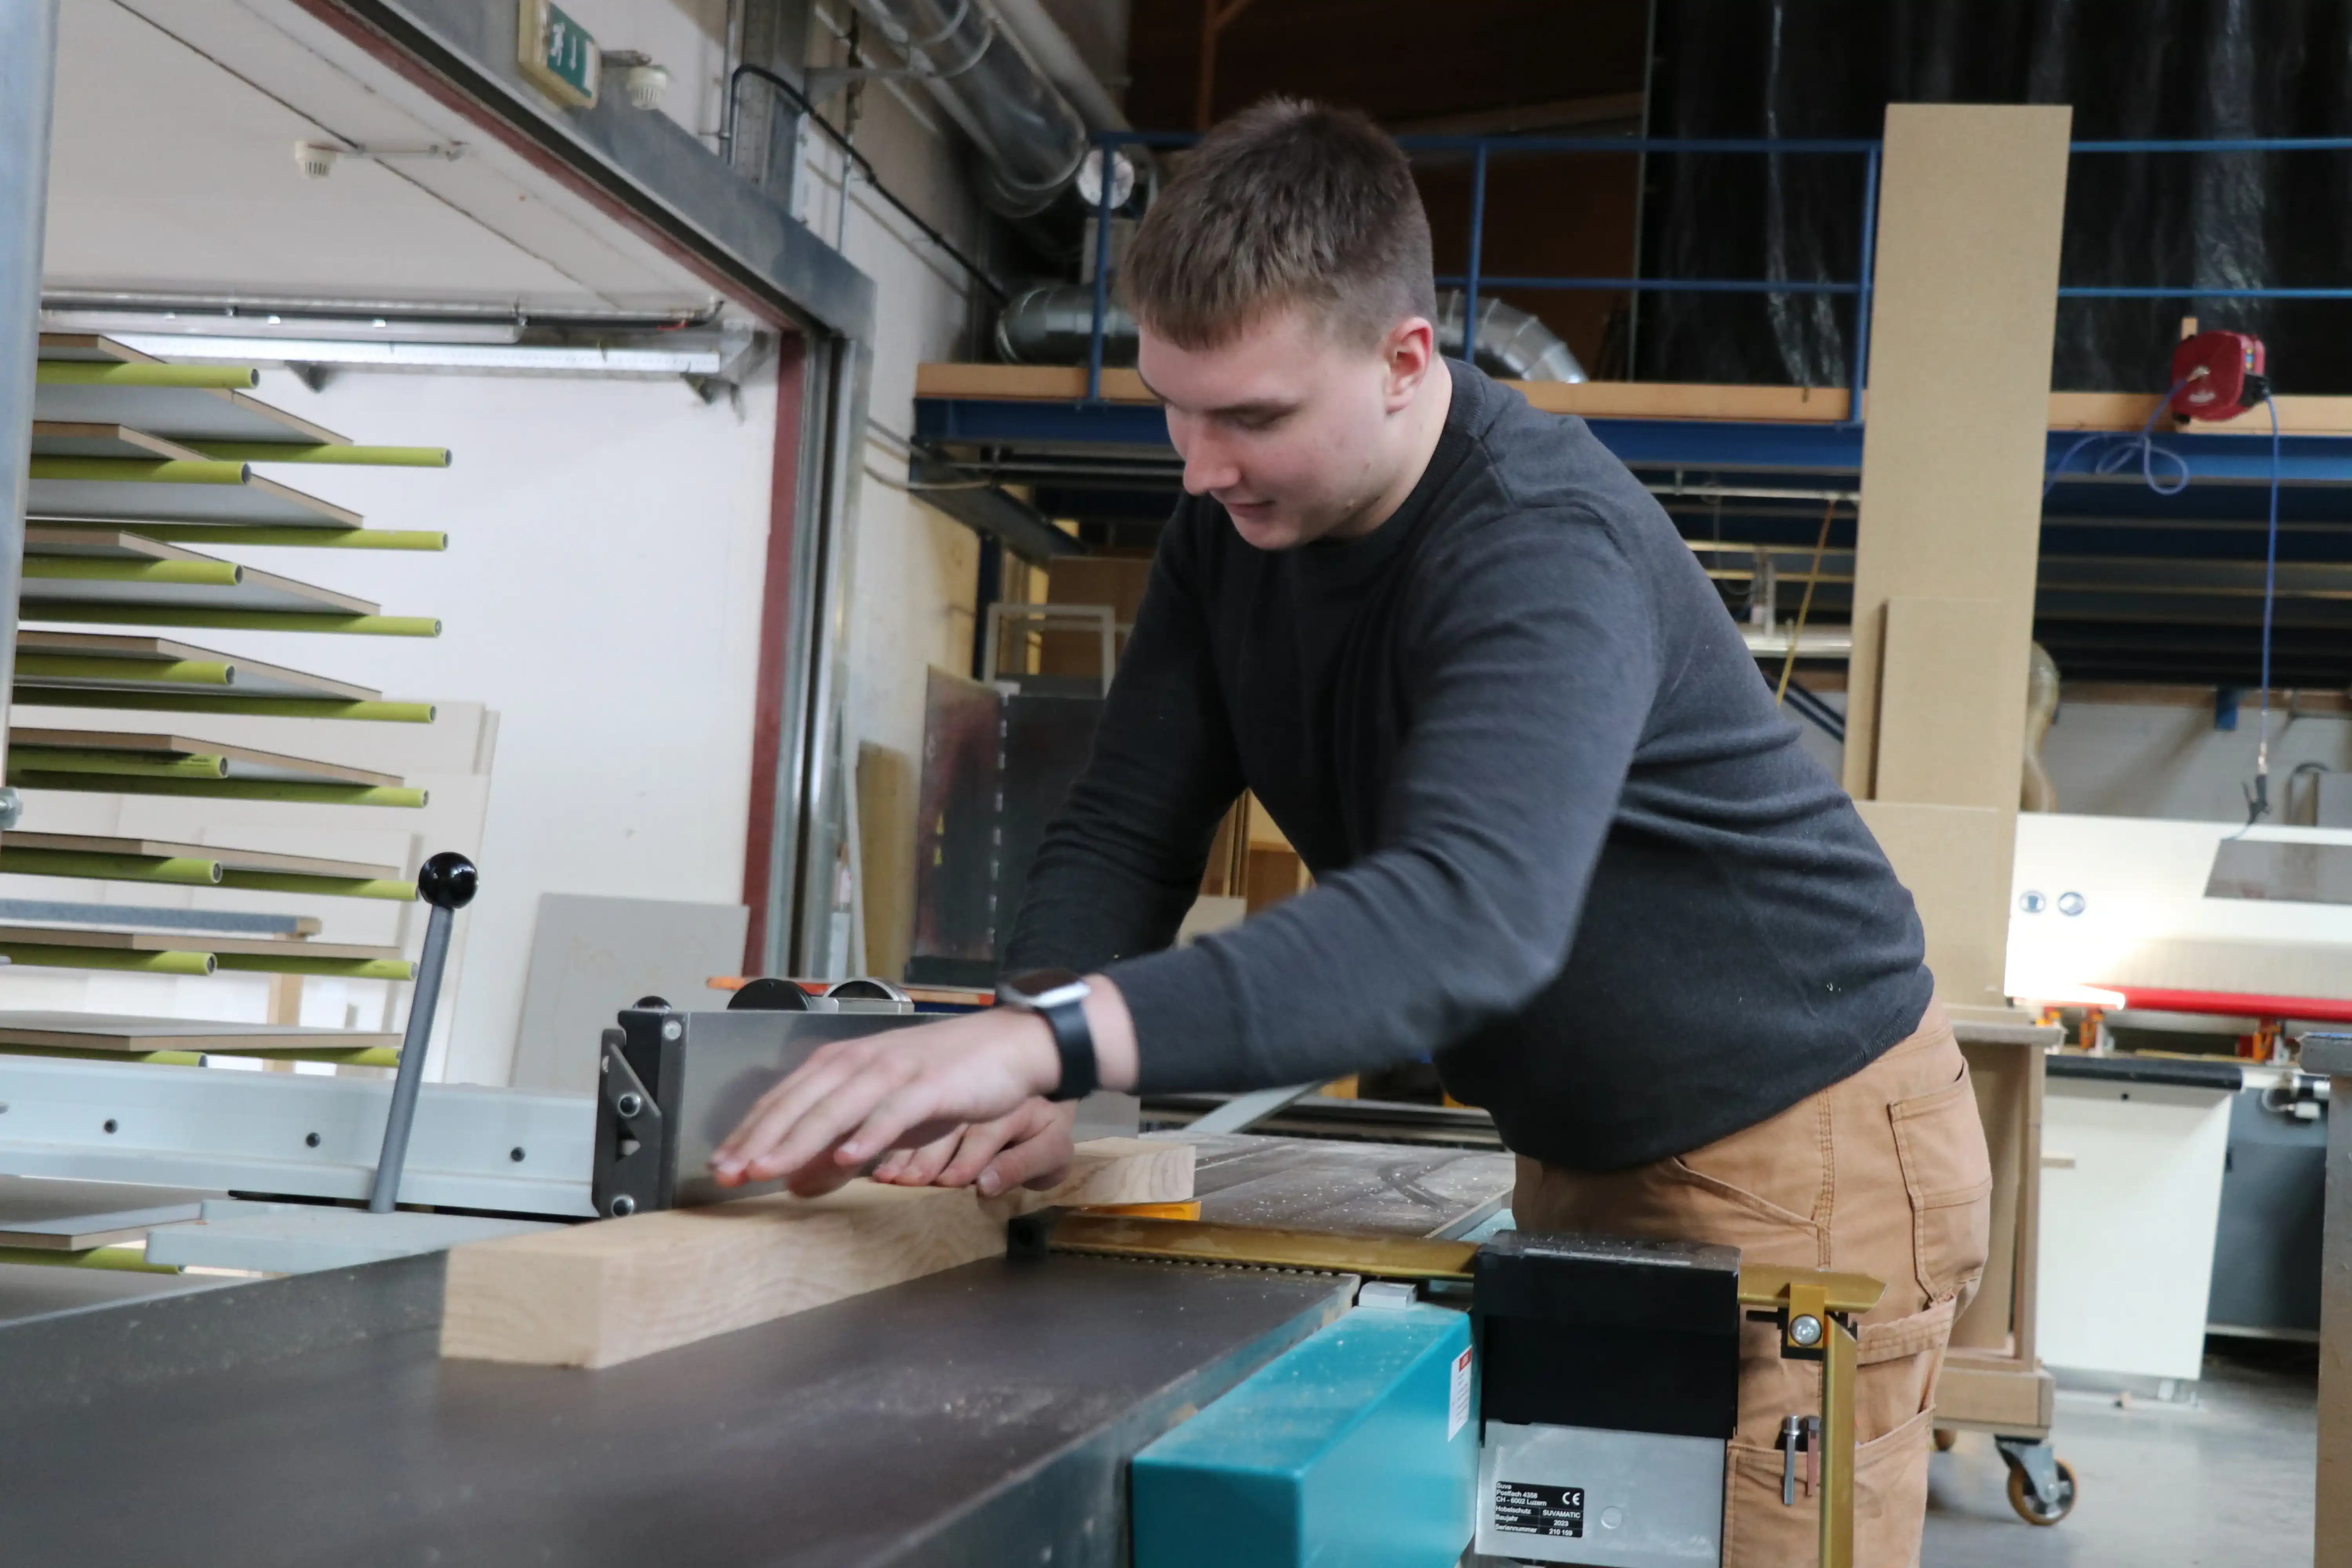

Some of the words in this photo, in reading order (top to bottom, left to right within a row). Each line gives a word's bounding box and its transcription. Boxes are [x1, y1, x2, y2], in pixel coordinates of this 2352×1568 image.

[1562, 1492, 1580, 1505] CE
[1496, 1506, 1531, 1514] Hobelschutz
[1543, 1509, 1581, 1518] SUVAMATIC
[1495, 1514, 1518, 1522] Baujahr
[1495, 1523, 1537, 1533] Seriennummer
